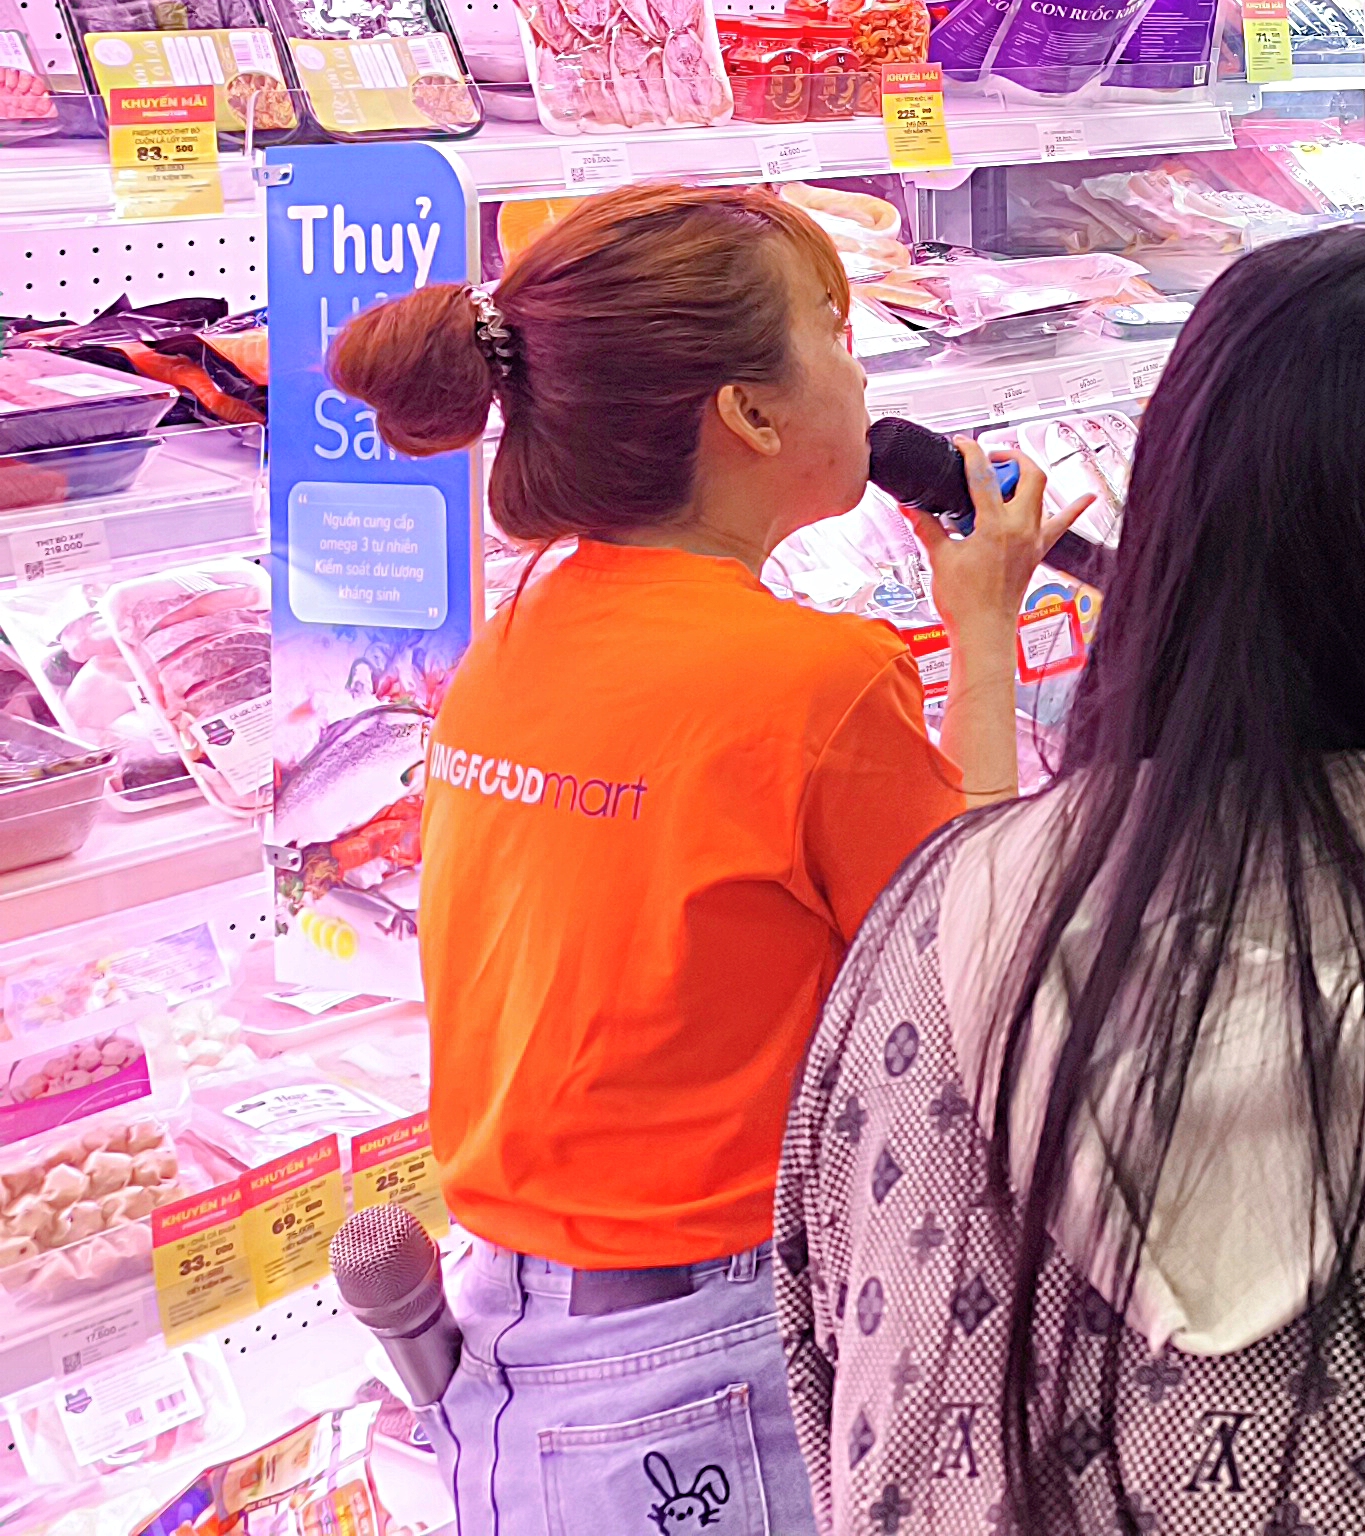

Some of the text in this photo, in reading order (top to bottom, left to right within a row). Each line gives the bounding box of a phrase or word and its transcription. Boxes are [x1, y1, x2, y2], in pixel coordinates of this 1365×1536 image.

[1030, 1, 1068, 18] CON
[120, 93, 209, 109] KHUYẾN MÃI
[287, 196, 441, 289] Thuỷ
[323, 511, 415, 532] Nguồn cung cấp
[319, 538, 358, 554] omega
[361, 536, 369, 552] 3
[386, 537, 419, 554] nhiên
[314, 557, 343, 575] Kiểm
[345, 560, 371, 576] soát
[390, 563, 424, 582] lượng
[338, 584, 401, 603] kháng sinh
[431, 740, 648, 821] INGFOODmart
[250, 1146, 333, 1190] KHUYẾN MÃI
[161, 1198, 219, 1229] KHUYẾN
